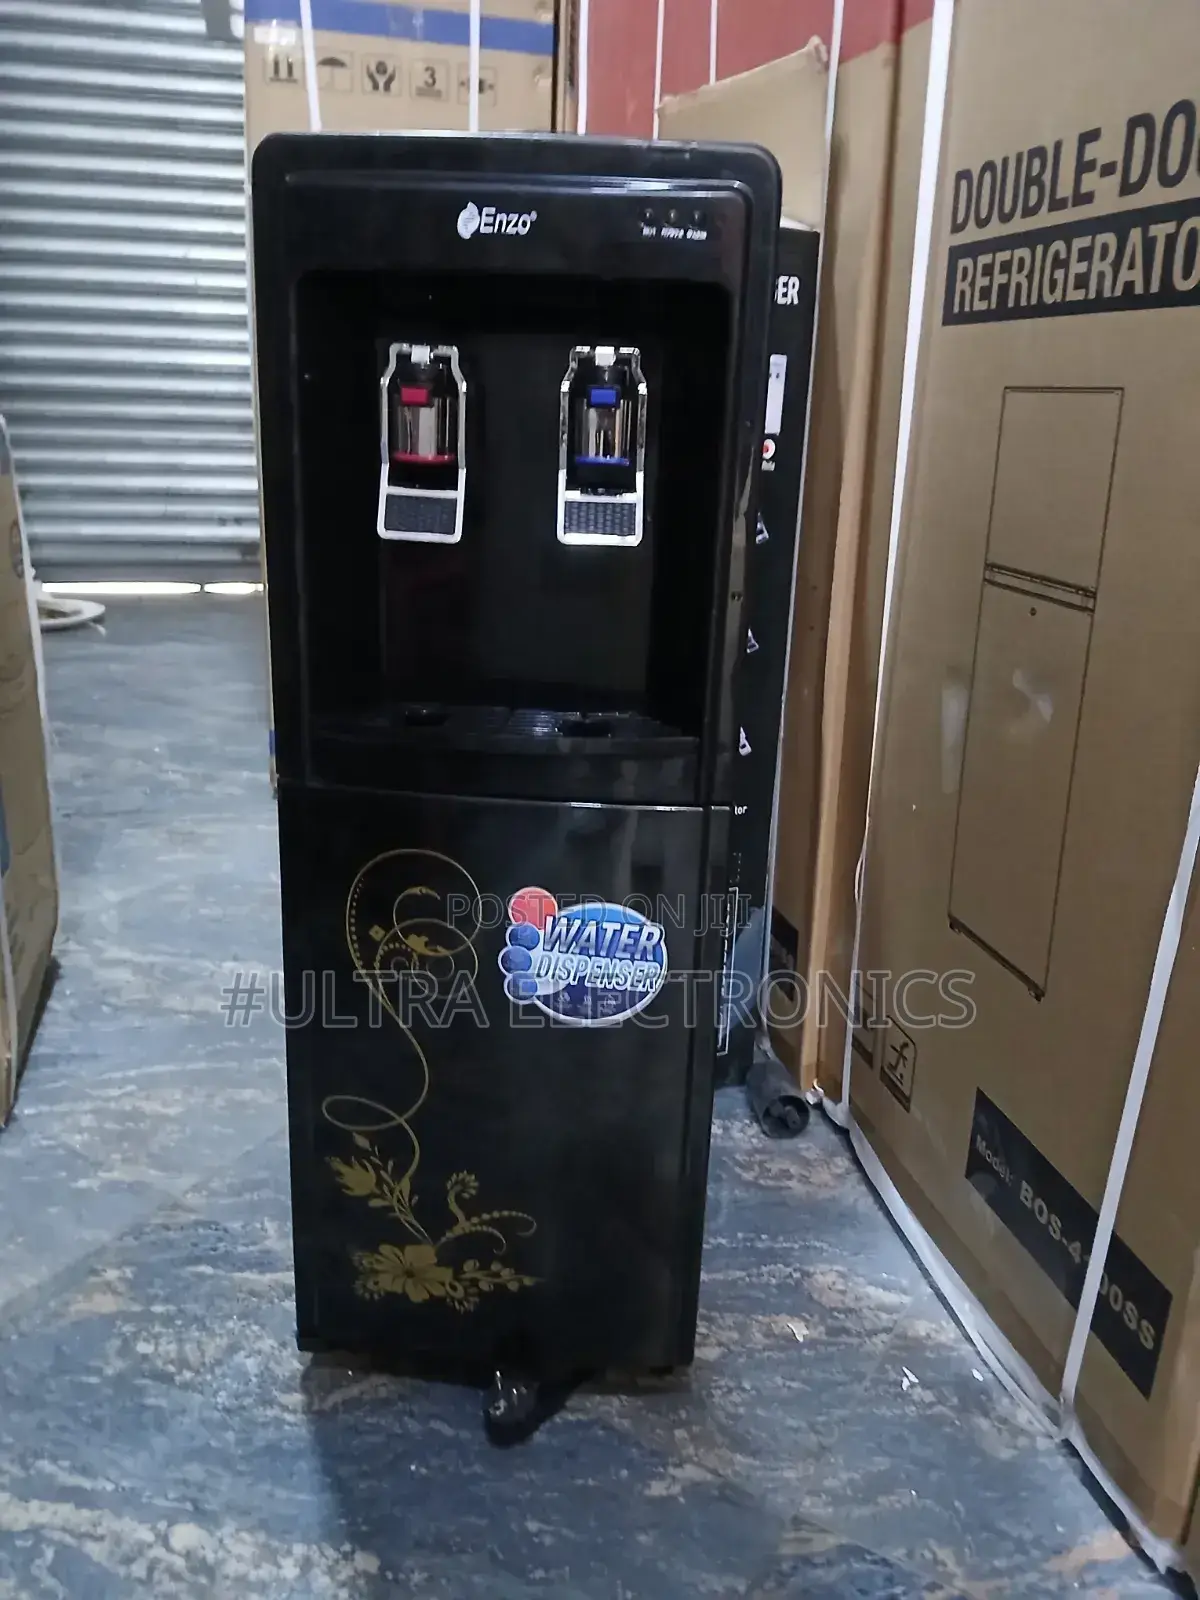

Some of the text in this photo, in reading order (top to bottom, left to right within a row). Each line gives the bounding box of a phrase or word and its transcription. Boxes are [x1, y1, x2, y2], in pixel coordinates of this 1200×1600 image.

[424, 66, 437, 88] 3
[950, 99, 1200, 235] DOUBLE-DO
[953, 216, 1200, 314] REFRIGERATO
[774, 275, 800, 305] ER
[543, 915, 661, 961] WATER
[535, 951, 661, 992] DISPENSER
[976, 1133, 1014, 1187] Model:
